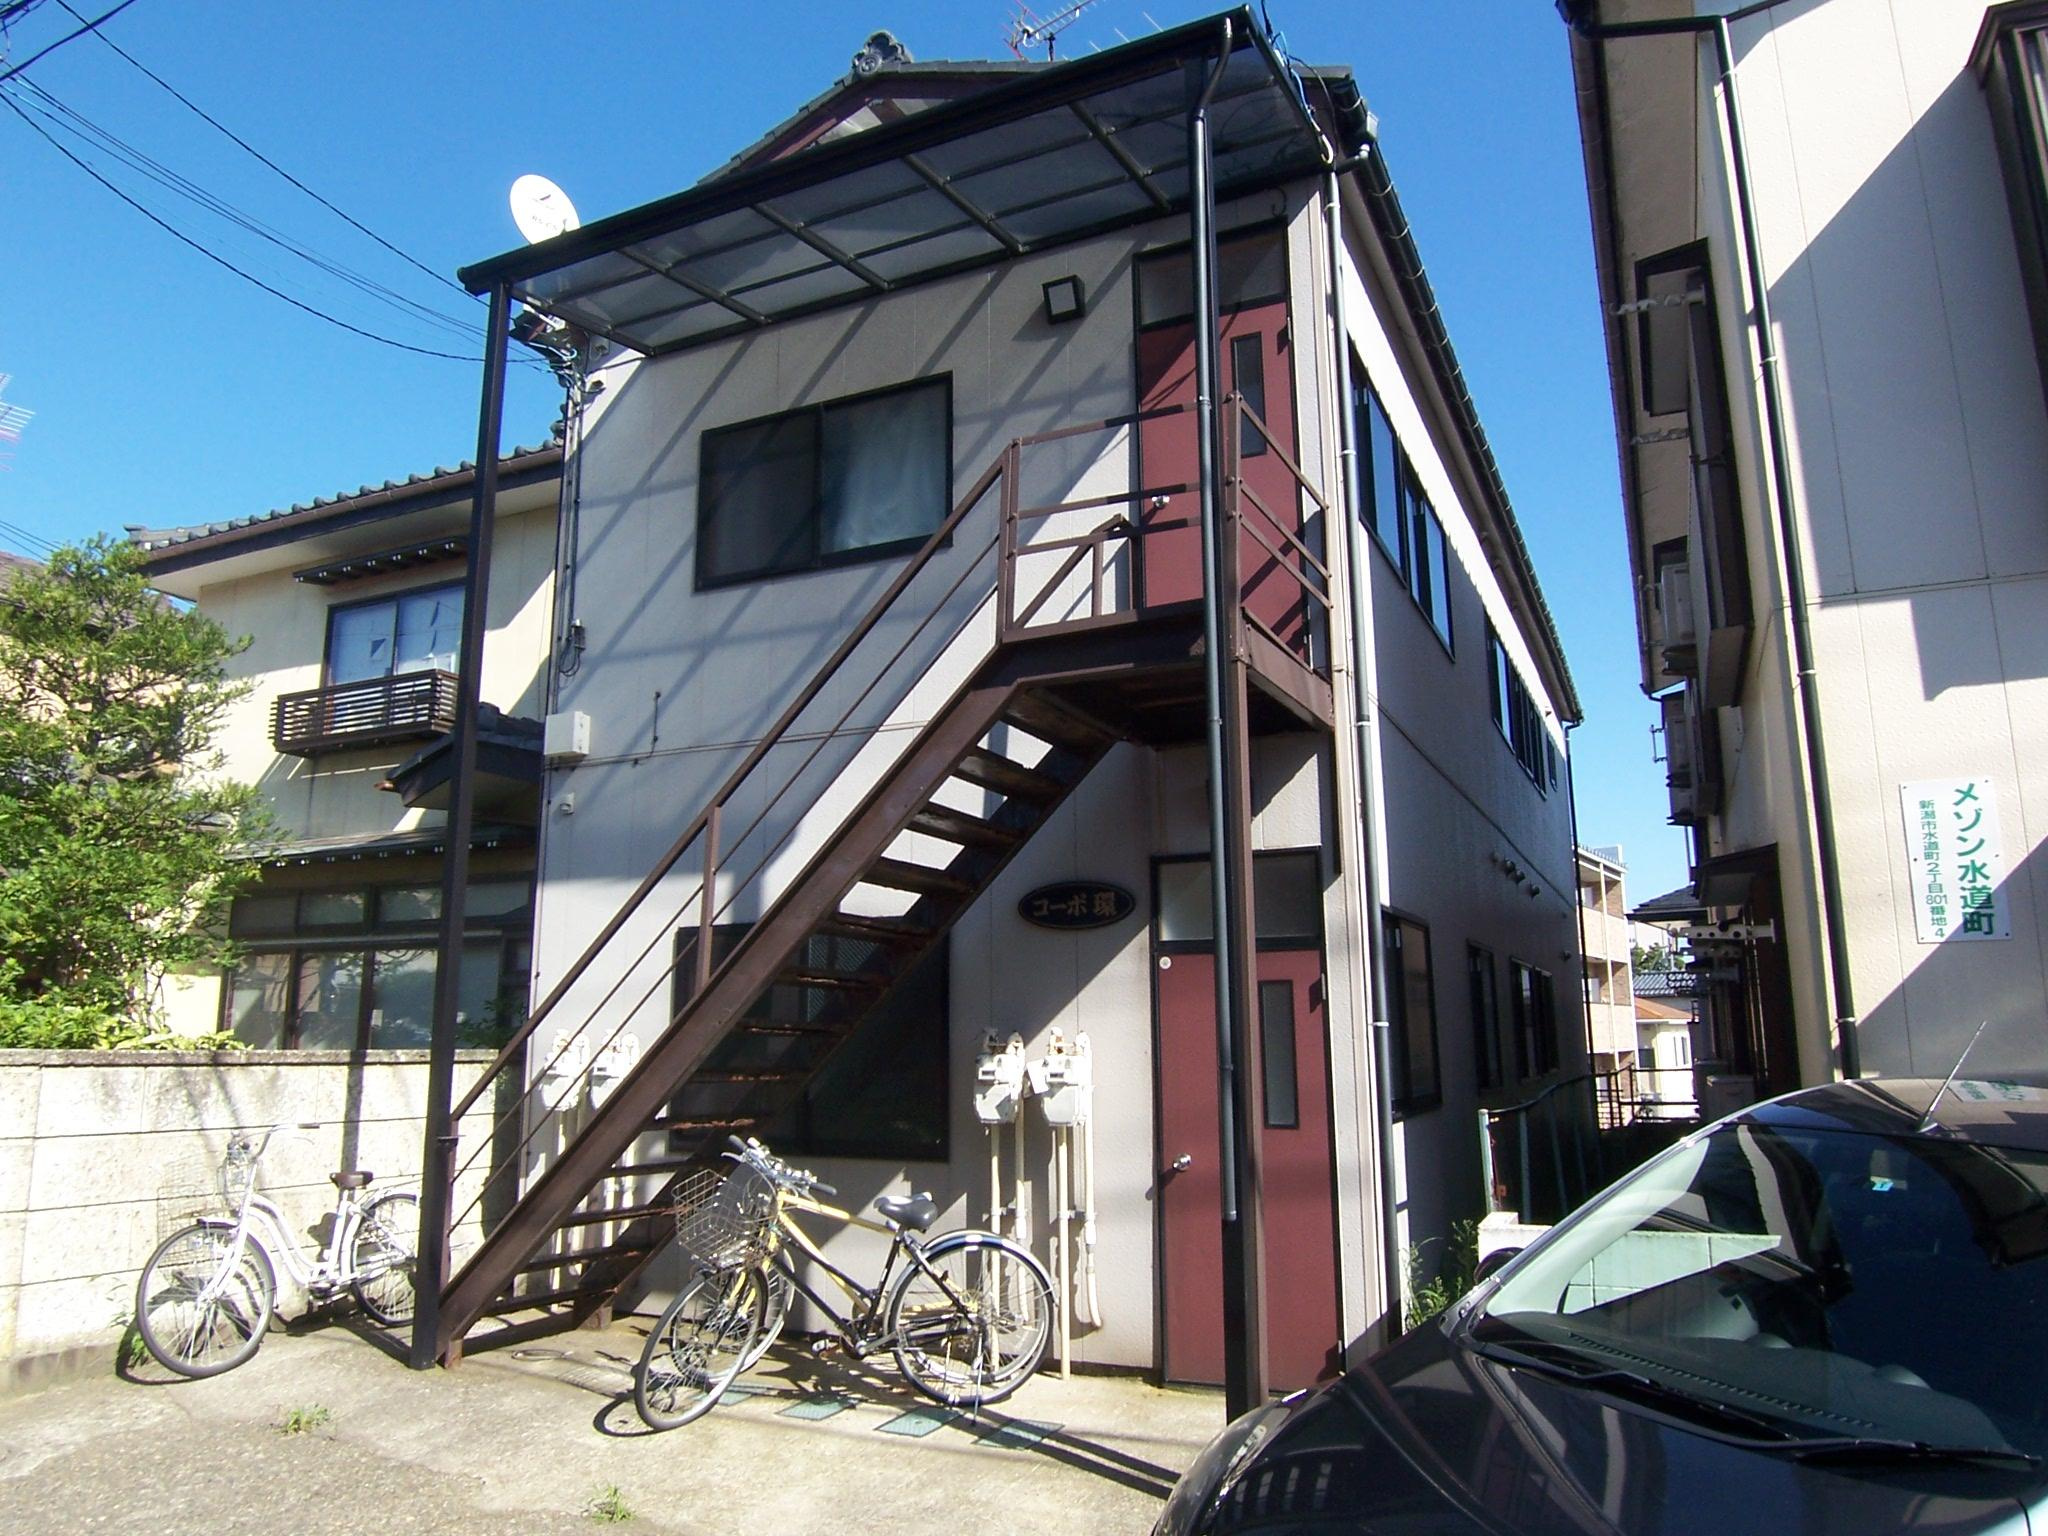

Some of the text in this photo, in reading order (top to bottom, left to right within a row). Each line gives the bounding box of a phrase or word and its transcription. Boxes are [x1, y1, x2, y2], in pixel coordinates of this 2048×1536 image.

[1953, 783, 1994, 935] メゾン水道町
